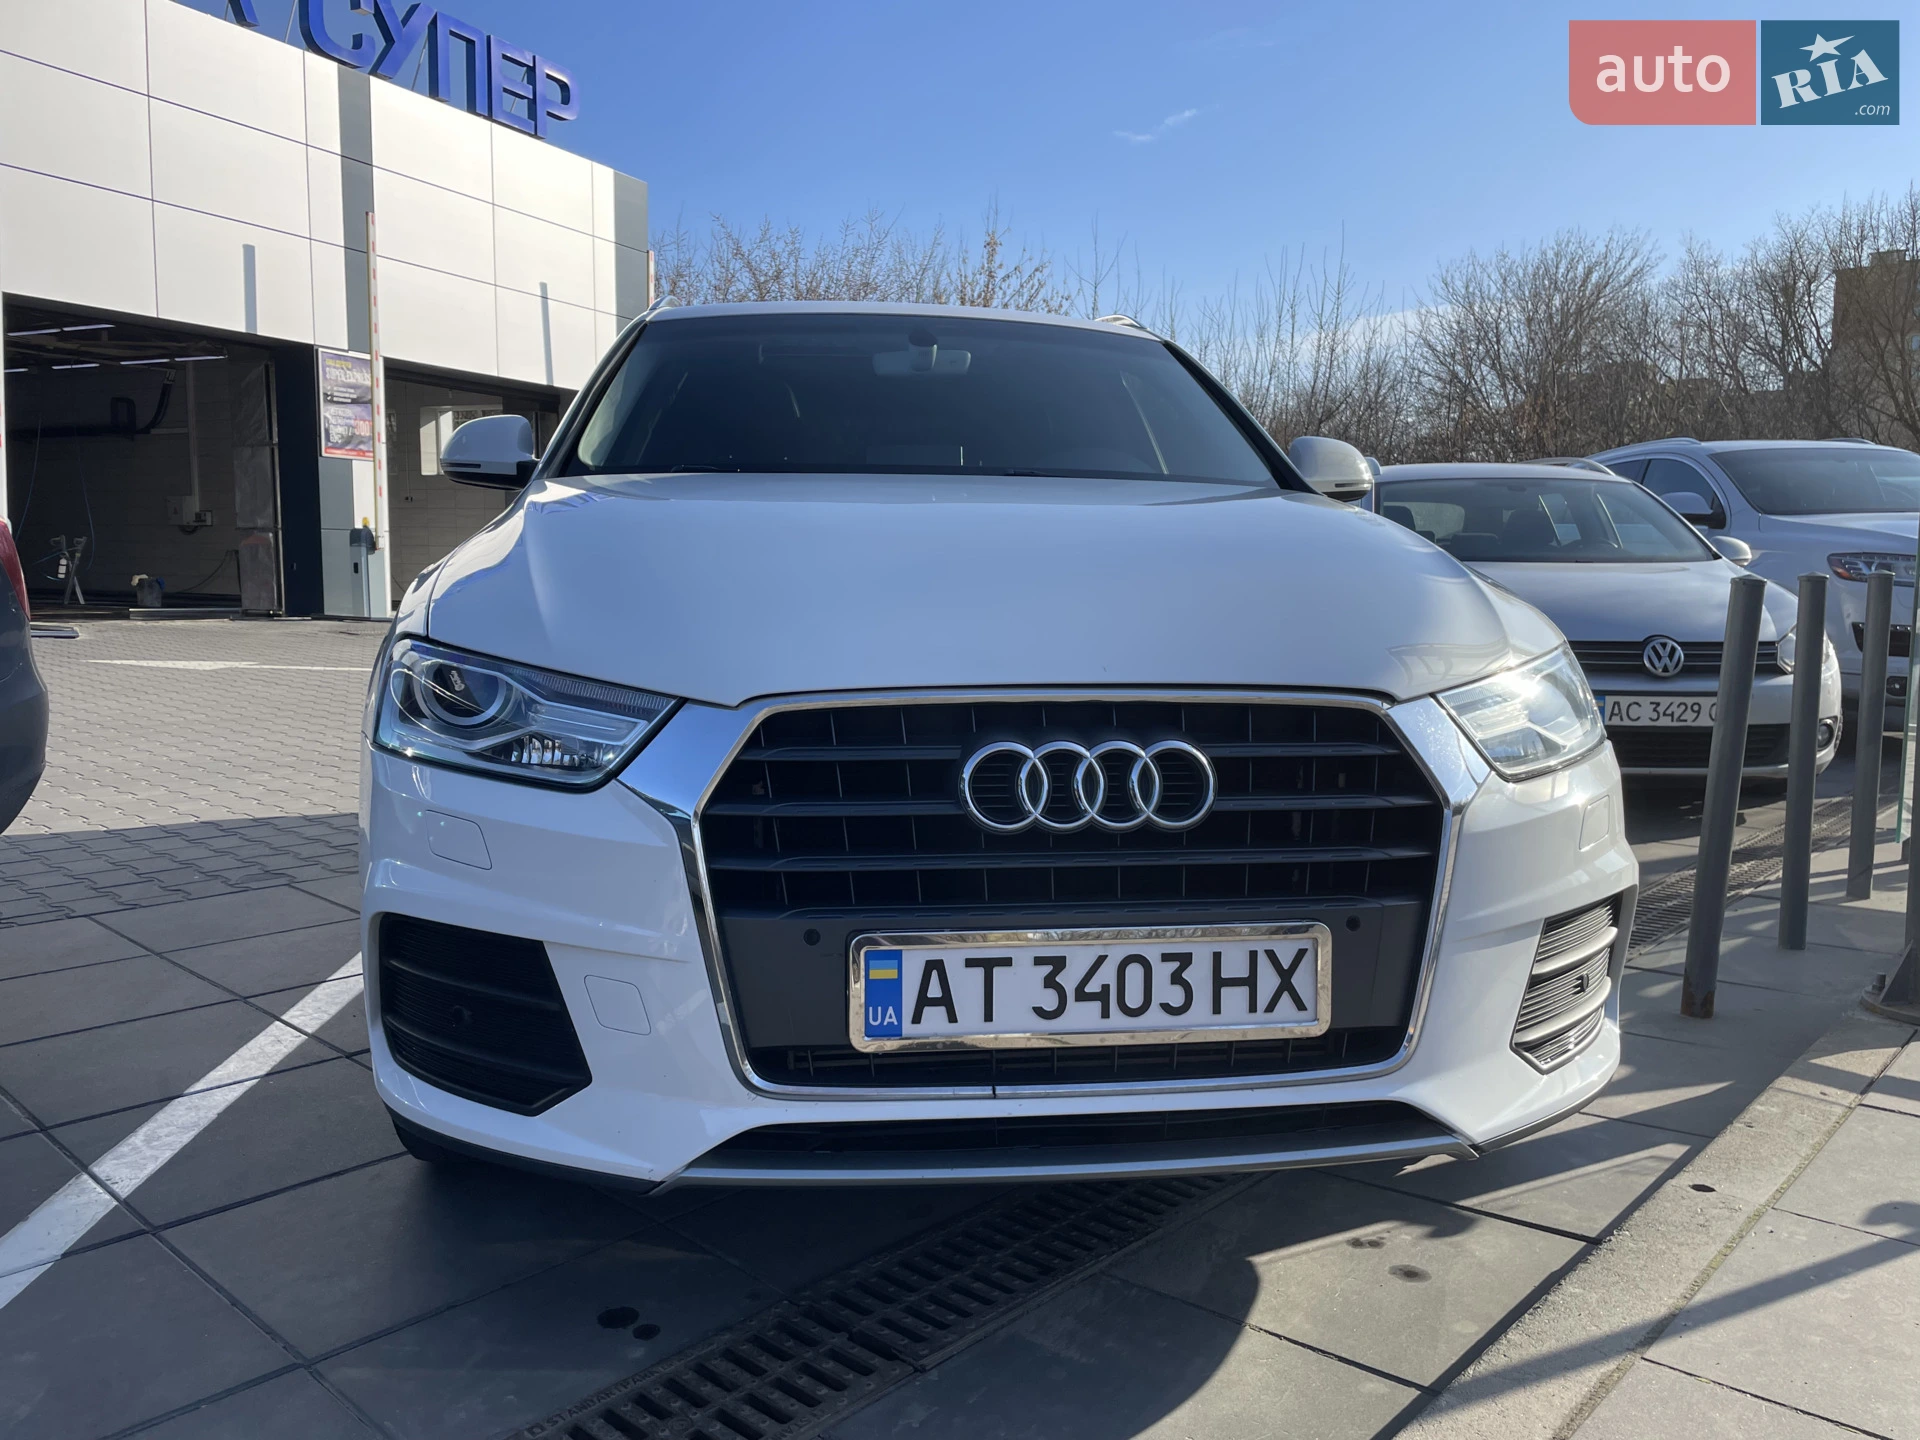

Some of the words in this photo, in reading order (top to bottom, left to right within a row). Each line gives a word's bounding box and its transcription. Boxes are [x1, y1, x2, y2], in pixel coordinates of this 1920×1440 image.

[299, 0, 580, 140] СУПЕР
[1608, 702, 1642, 722] AC
[1648, 702, 1702, 723] 3429
[911, 957, 1013, 1024] AT
[1031, 952, 1194, 1021] 3403
[1212, 948, 1309, 1016] HX
[868, 1006, 898, 1026] UA
